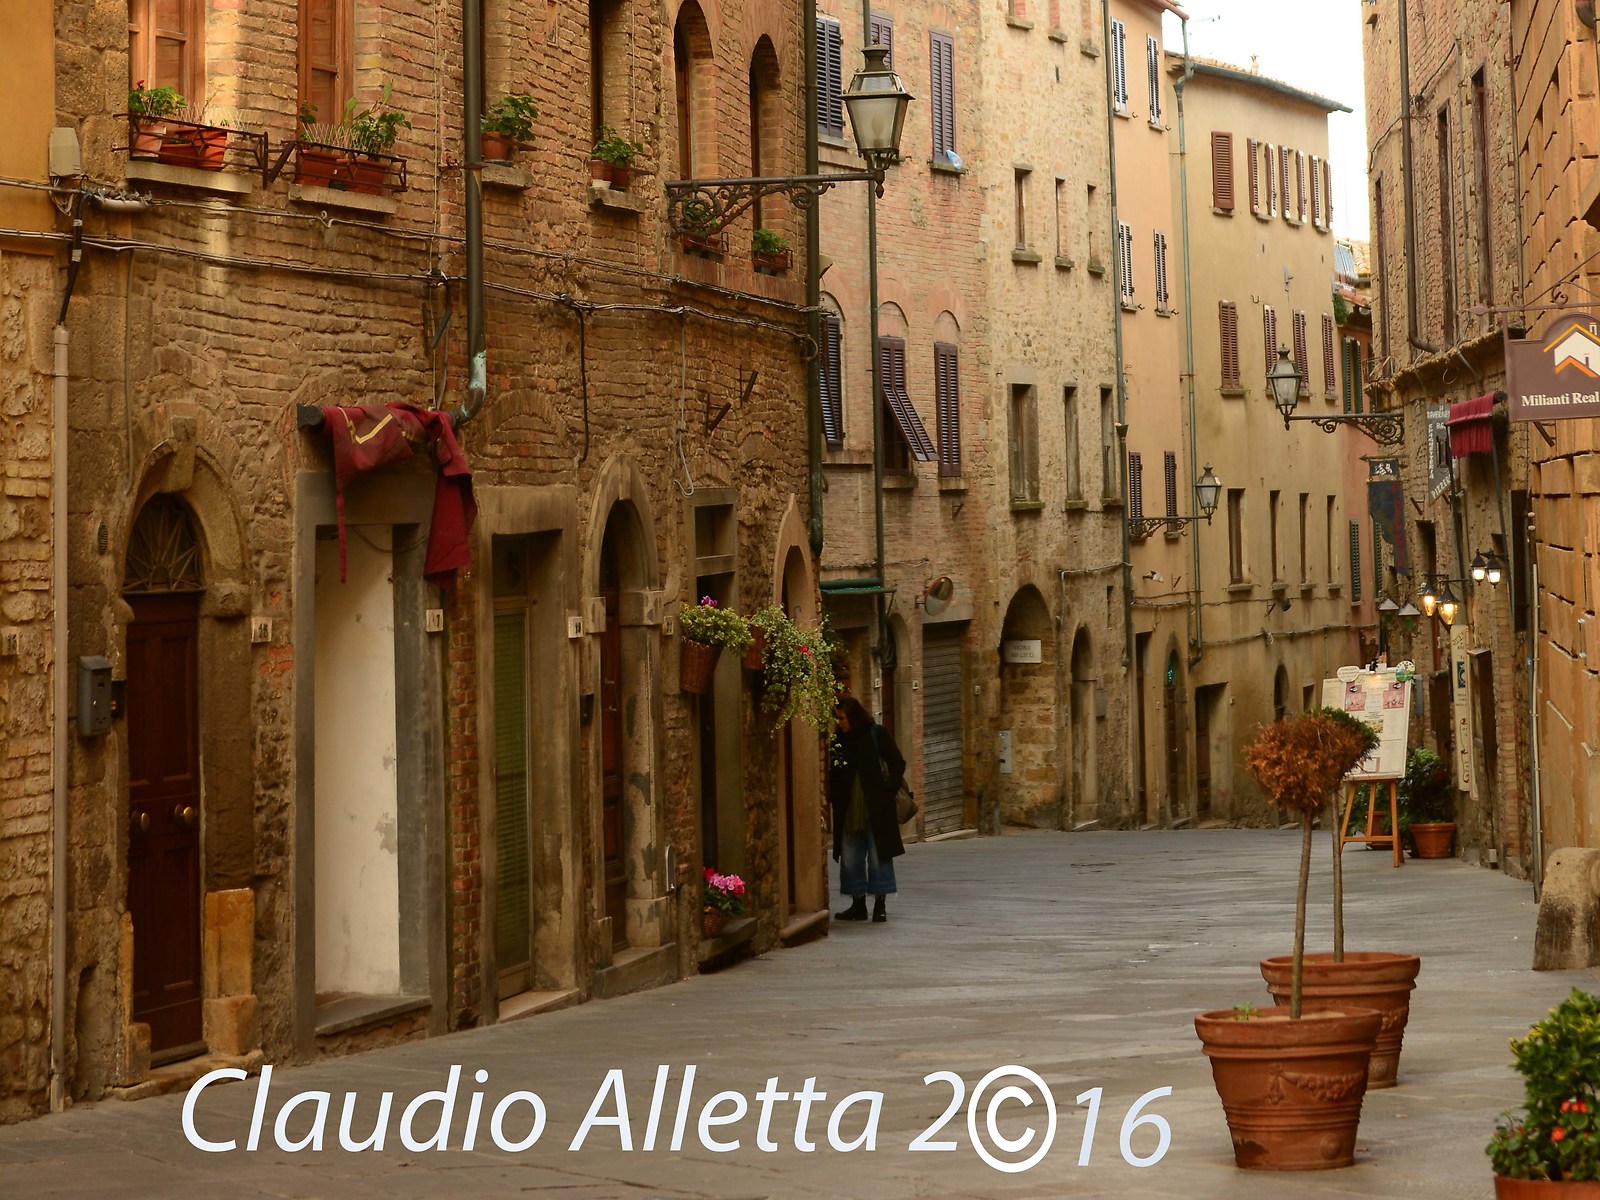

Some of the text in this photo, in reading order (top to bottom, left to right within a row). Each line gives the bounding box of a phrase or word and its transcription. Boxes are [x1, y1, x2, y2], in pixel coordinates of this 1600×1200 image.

[1521, 391, 1600, 407] Milianti Real
[1431, 474, 1451, 499] PIZZER
